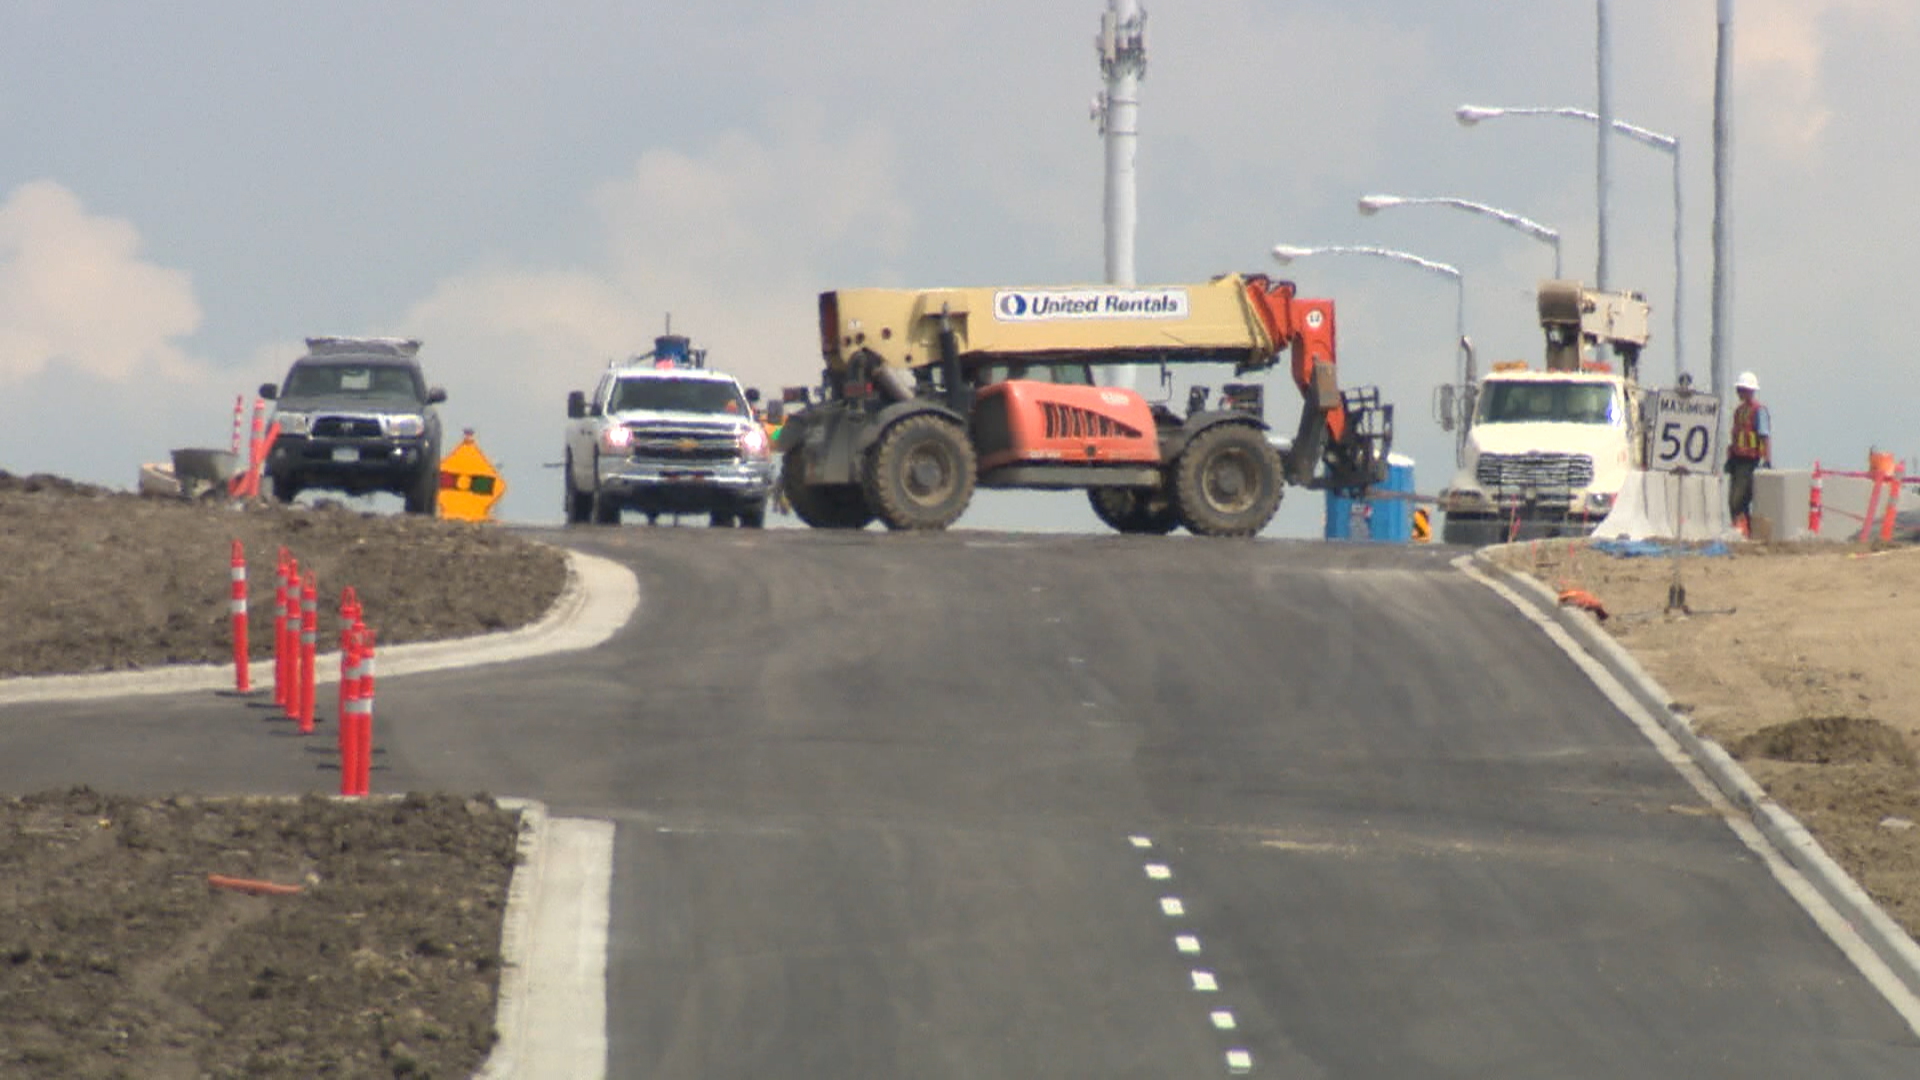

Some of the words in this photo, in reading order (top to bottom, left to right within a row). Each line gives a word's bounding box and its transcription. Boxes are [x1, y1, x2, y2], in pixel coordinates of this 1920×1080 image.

[1032, 296, 1099, 315] United
[1105, 295, 1178, 313] Rentals
[1660, 398, 1717, 416] MAXIMUM
[1659, 422, 1709, 463] 50
